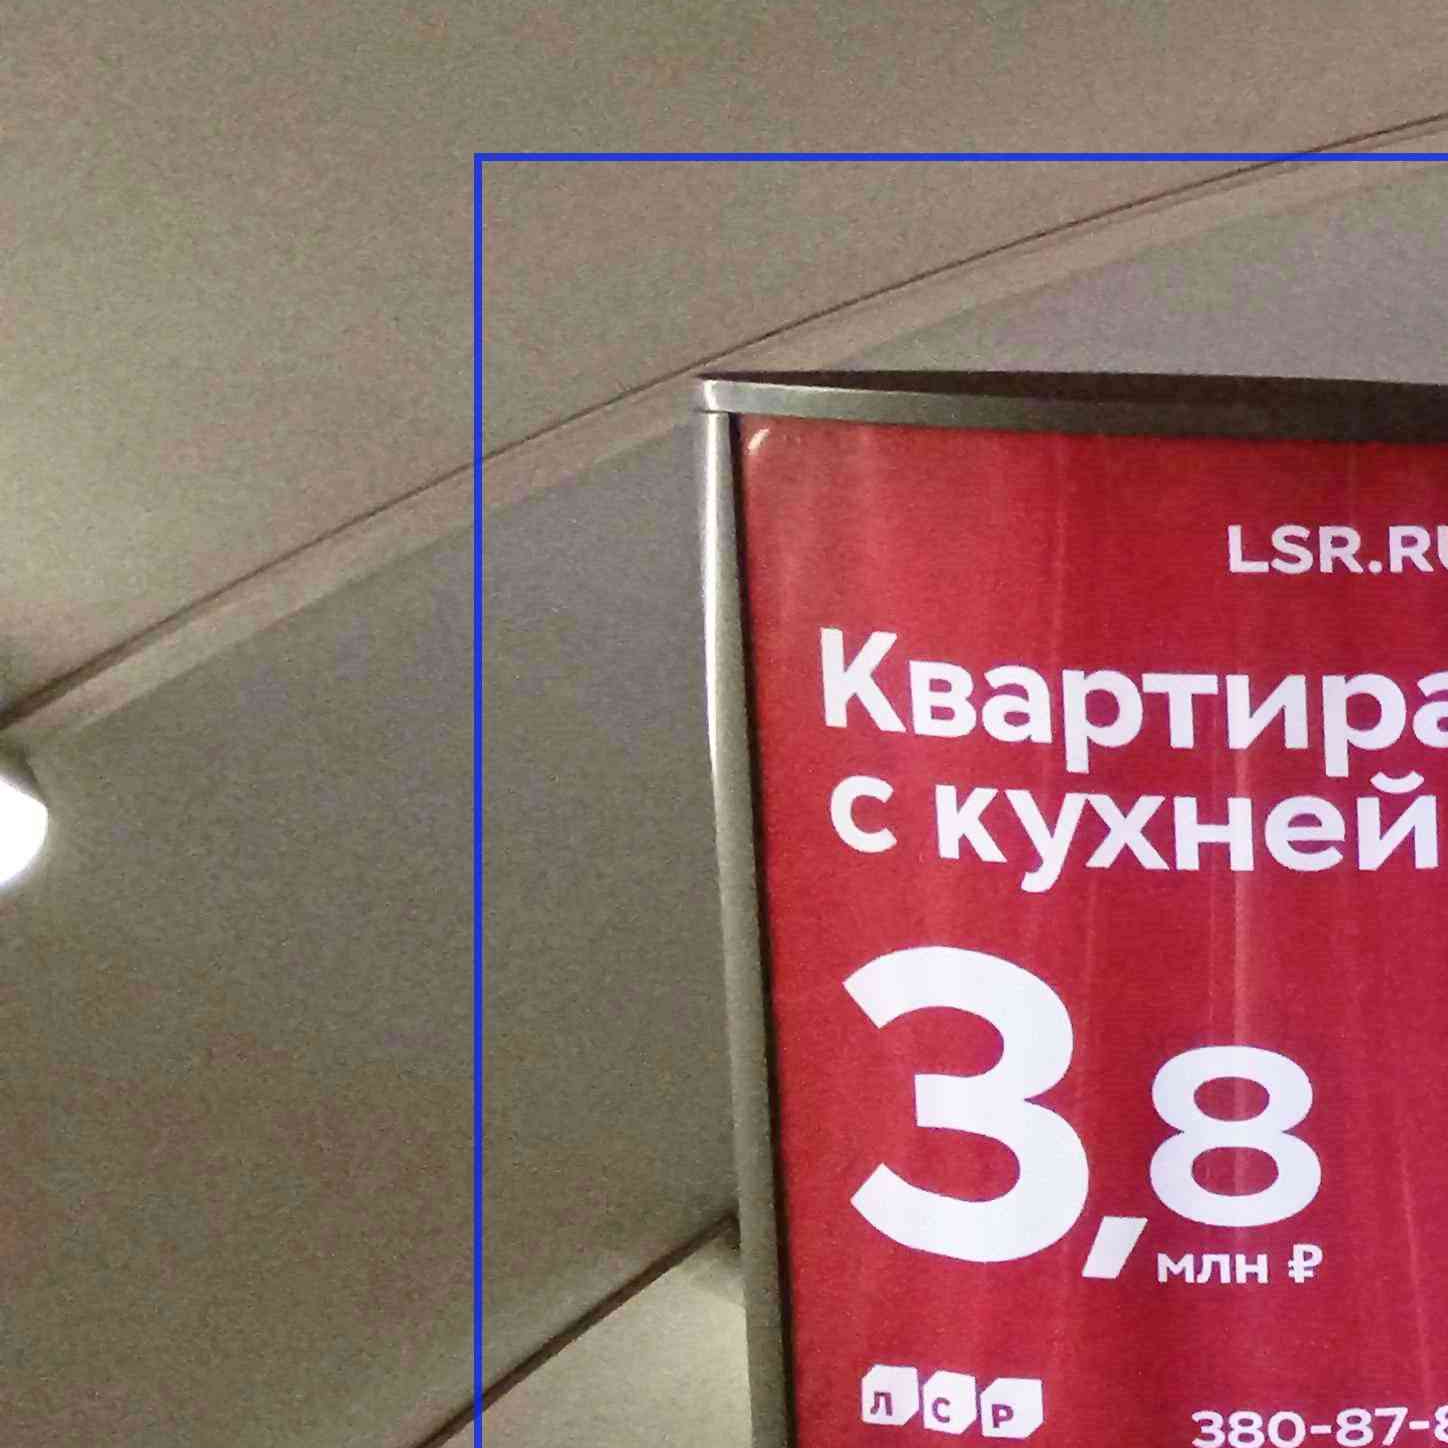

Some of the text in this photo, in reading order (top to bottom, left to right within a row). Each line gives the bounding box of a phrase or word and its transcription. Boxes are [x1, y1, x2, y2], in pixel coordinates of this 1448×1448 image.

[829, 769, 1440, 893] с кухней
[1156, 1252, 1269, 1284] млн
